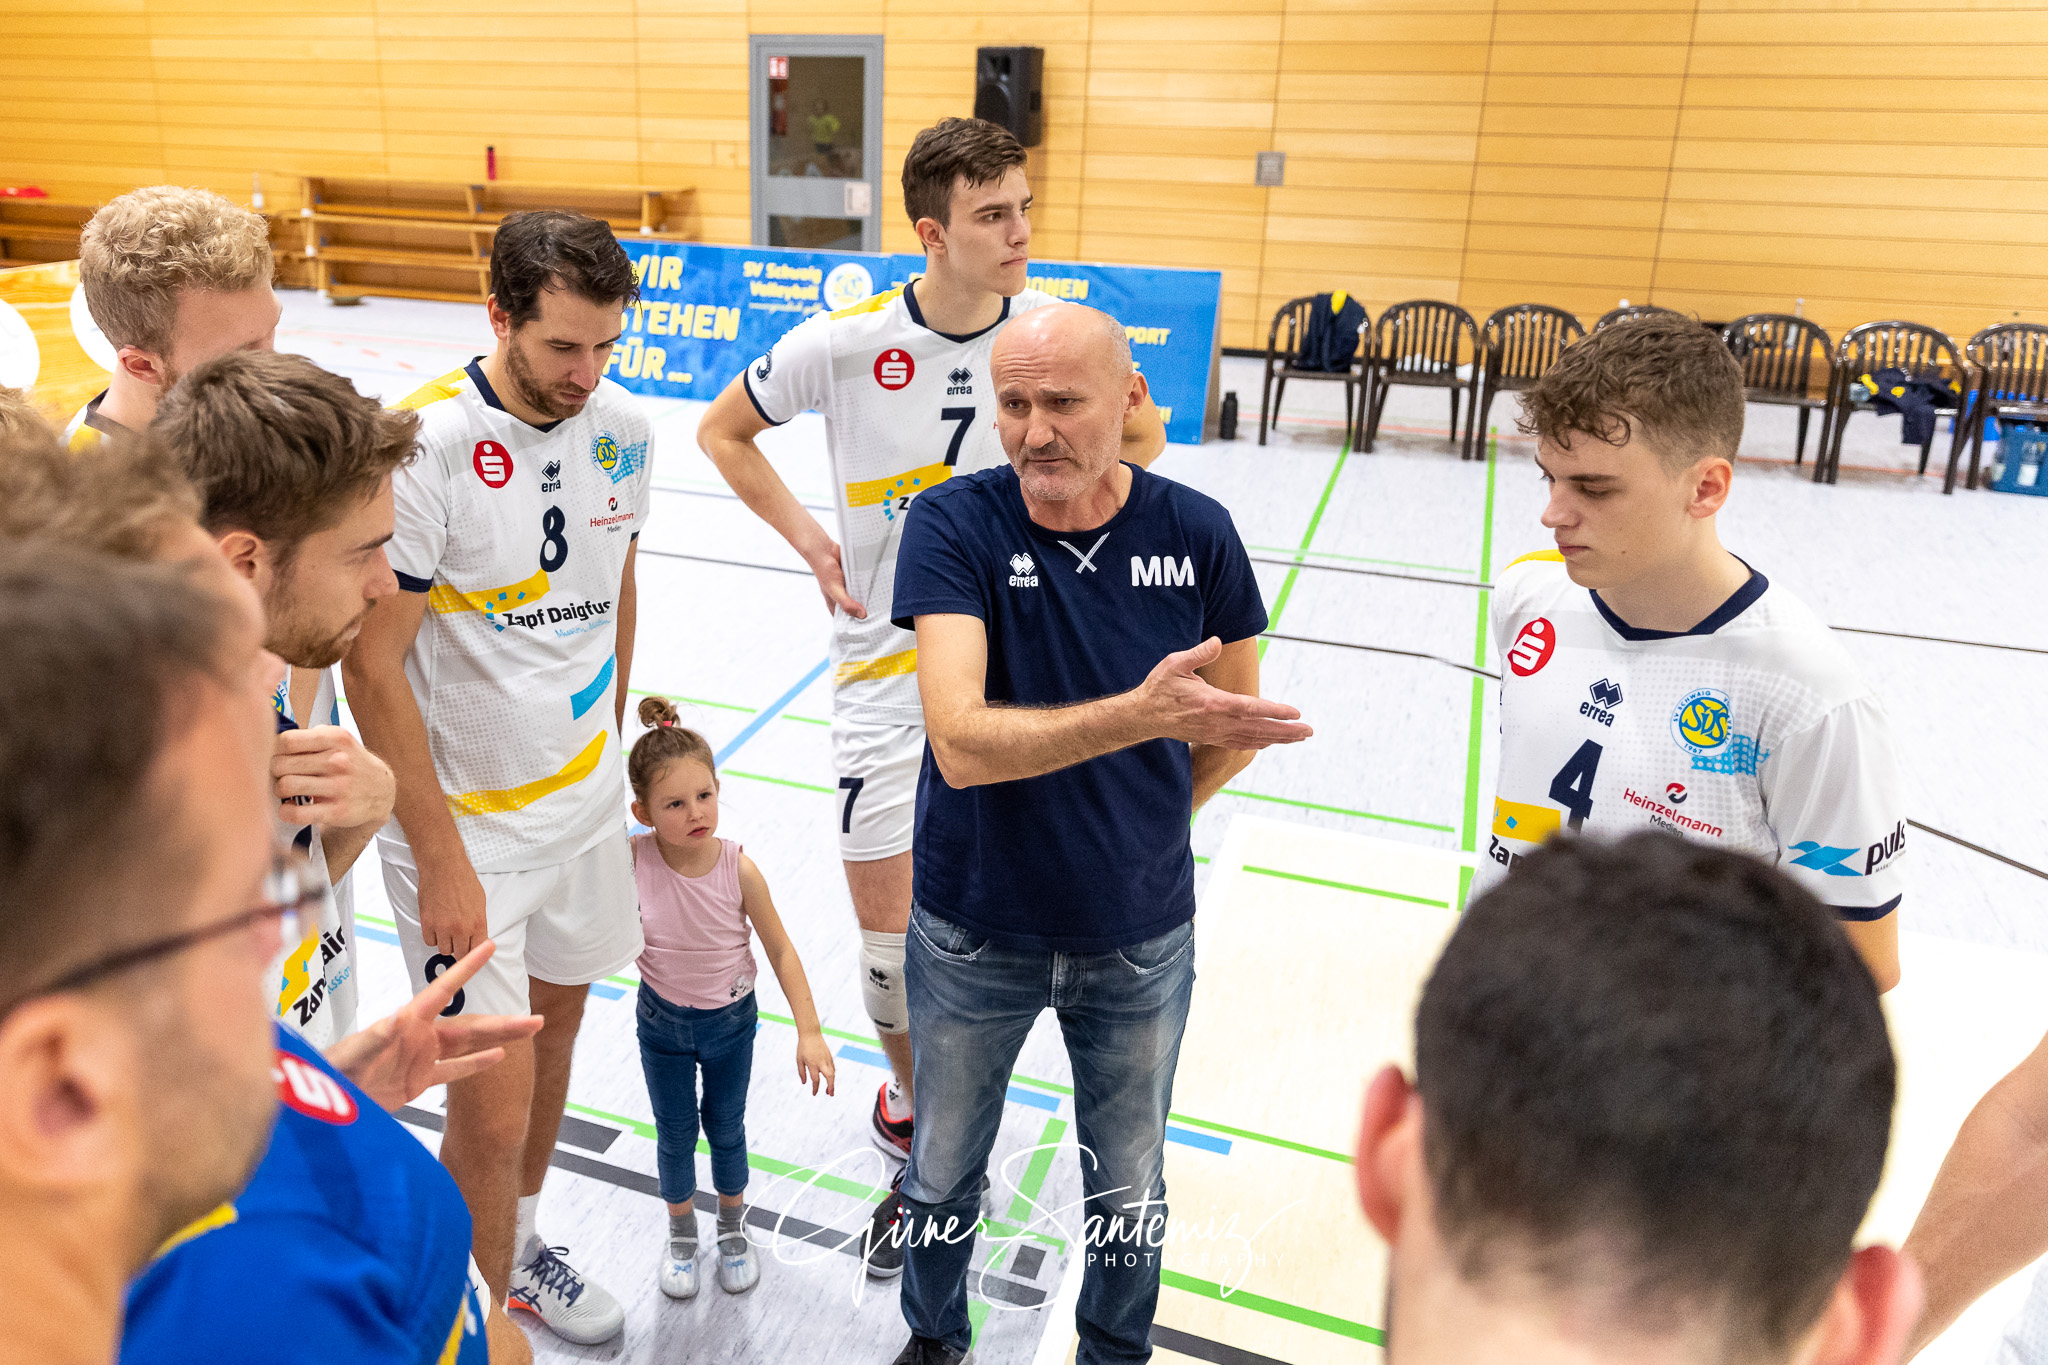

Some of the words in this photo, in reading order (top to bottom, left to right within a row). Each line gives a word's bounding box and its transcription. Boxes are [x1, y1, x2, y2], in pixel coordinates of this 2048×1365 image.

[743, 261, 764, 277] SV
[1125, 326, 1171, 346] PORT
[946, 385, 972, 395] errea
[940, 406, 976, 467] 7
[590, 512, 634, 528] Heinzelmann
[539, 505, 569, 573] 8
[1009, 575, 1039, 588] errea
[1131, 556, 1195, 587] MM
[502, 608, 546, 630] Zapf
[1579, 701, 1615, 728] errea
[1684, 743, 1703, 754] 1967
[1549, 738, 1604, 834] 4
[838, 776, 865, 834] 7
[1623, 787, 1723, 838] Heinzelmann
